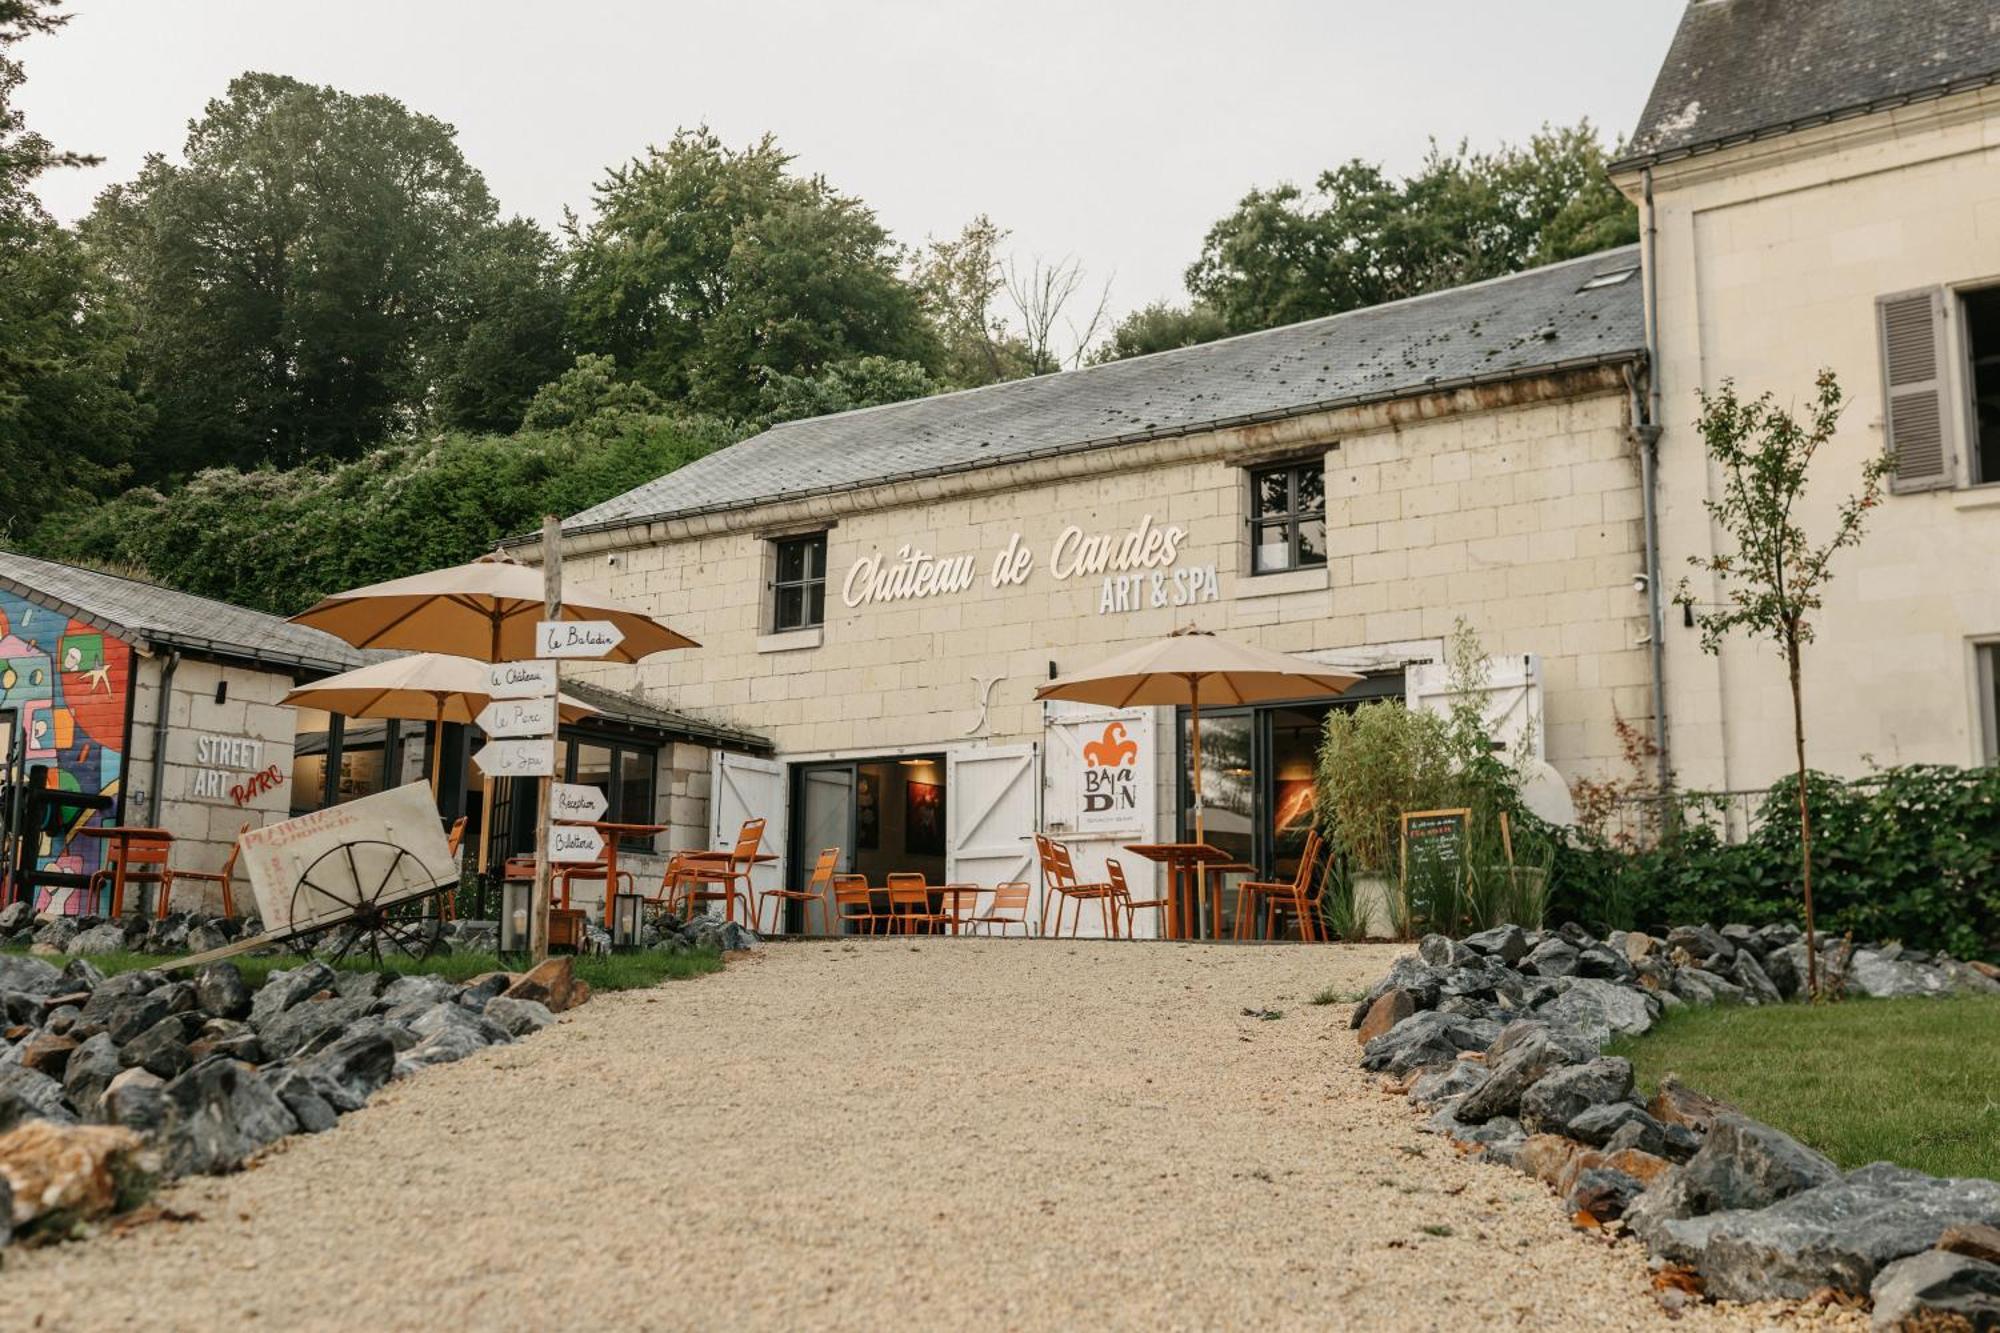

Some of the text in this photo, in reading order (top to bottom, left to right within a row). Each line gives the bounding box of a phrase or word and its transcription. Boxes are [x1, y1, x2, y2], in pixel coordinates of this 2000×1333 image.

[842, 514, 1189, 608] Château de Candes
[1100, 564, 1220, 614] ART & SPA
[566, 626, 613, 646] Baladin
[513, 705, 541, 724] Parc
[197, 735, 264, 769] STREET
[193, 764, 284, 807] ART PARC
